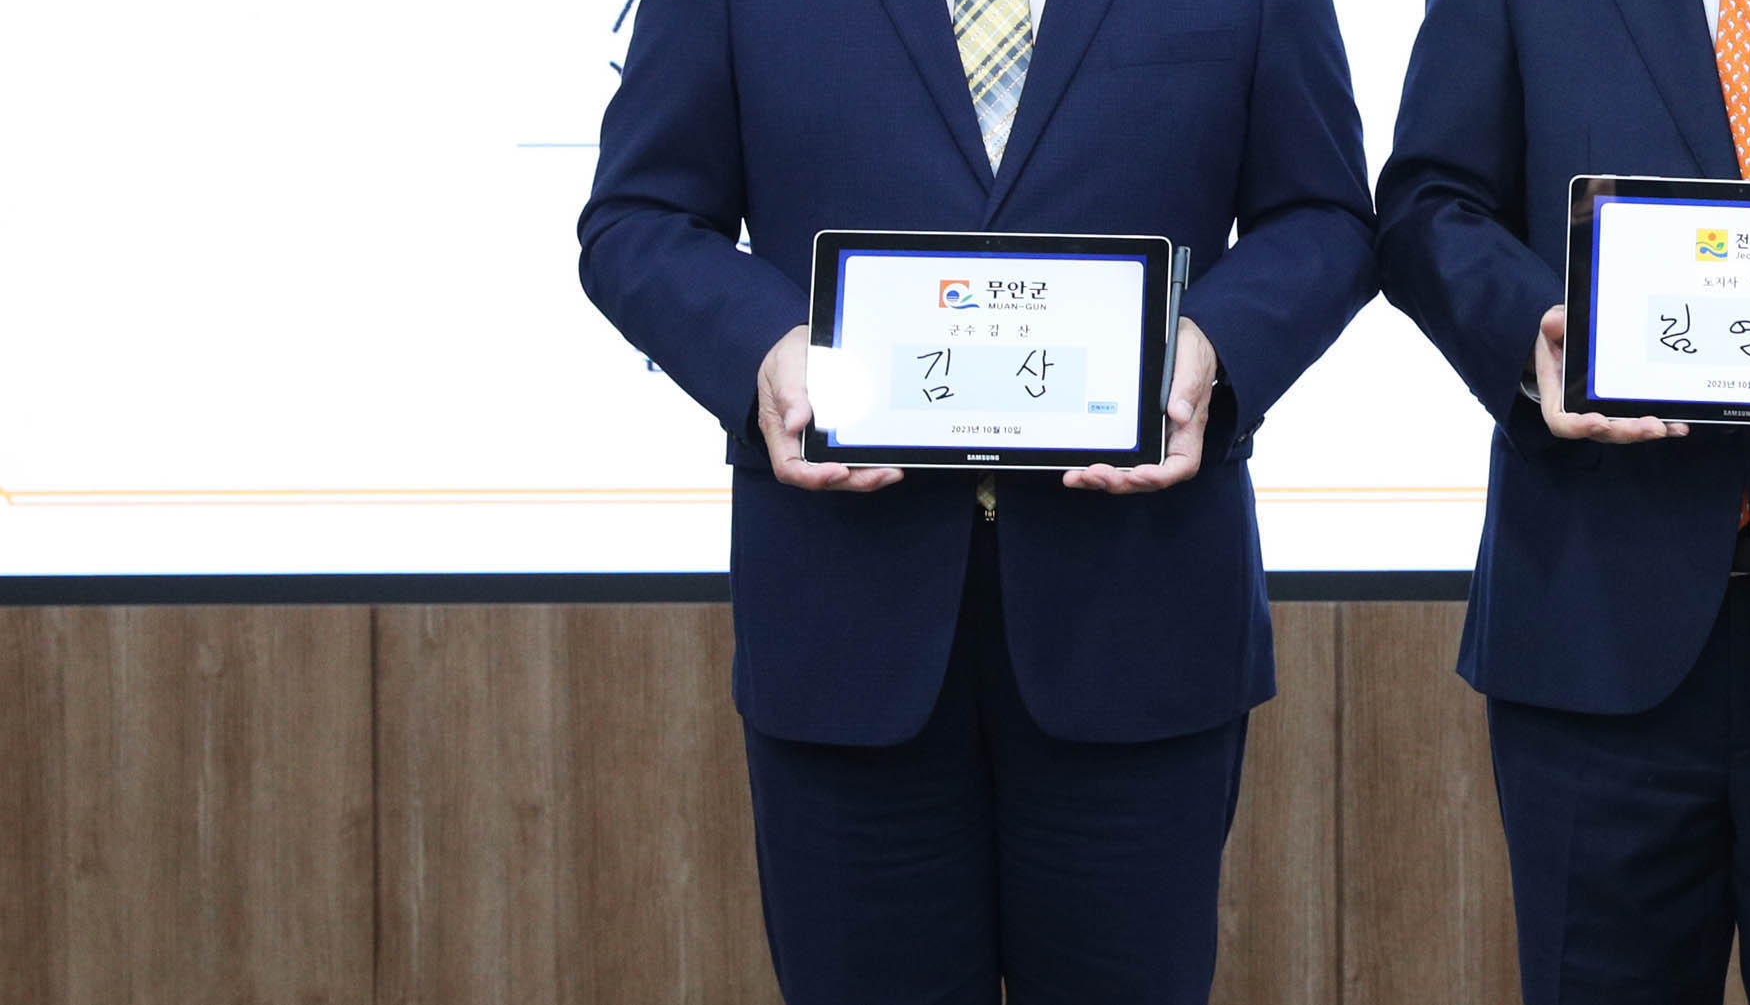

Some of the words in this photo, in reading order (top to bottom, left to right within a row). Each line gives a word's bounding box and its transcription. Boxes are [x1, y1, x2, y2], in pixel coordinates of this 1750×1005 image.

[985, 280, 1049, 300] 무안군
[987, 302, 1048, 311] MUAN-GUN
[966, 453, 1001, 462] SAMSUNG
